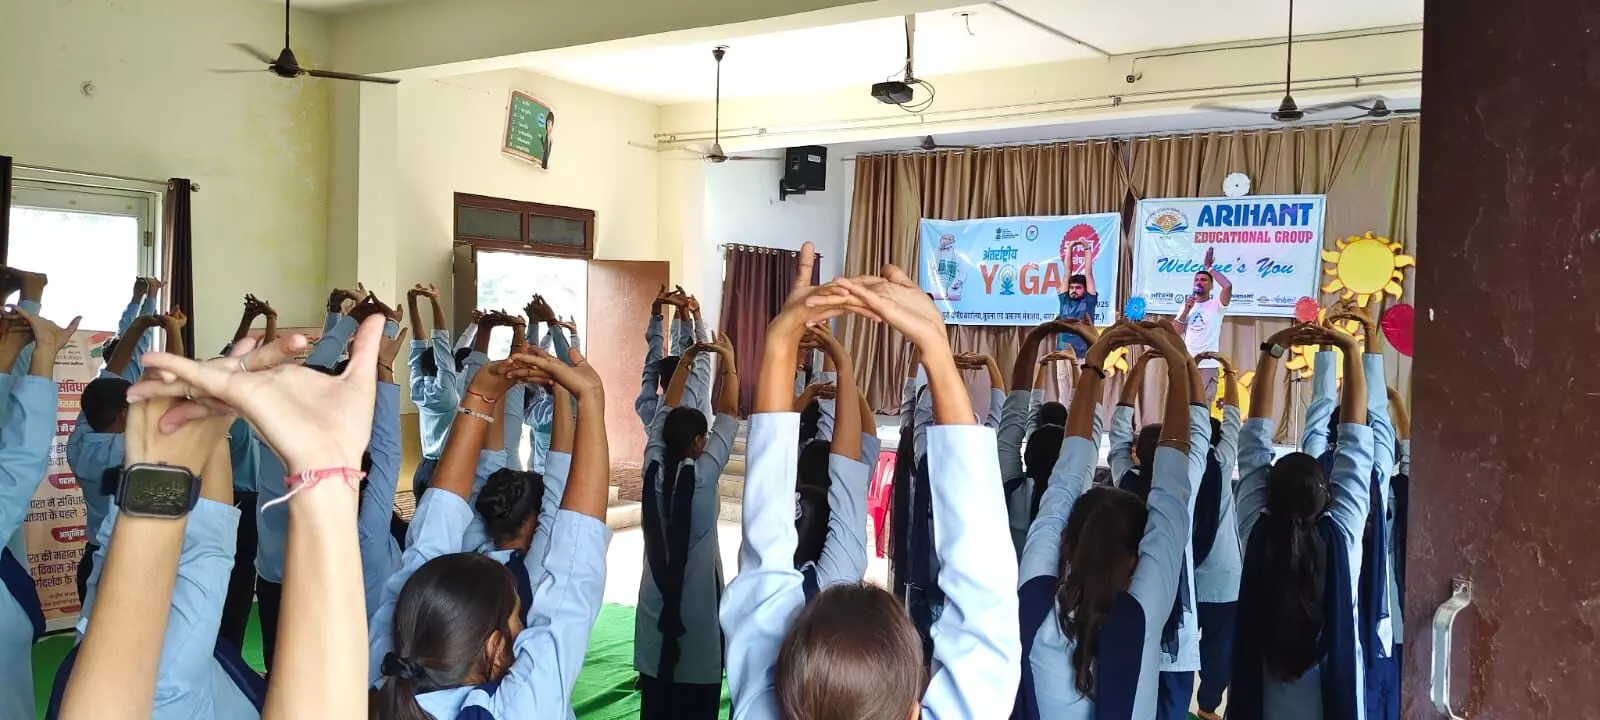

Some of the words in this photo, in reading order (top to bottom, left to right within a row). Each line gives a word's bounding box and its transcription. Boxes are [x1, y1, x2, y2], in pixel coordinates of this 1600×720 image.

[1197, 203, 1314, 228] ARIHANT
[1194, 231, 1271, 244] EDUCATIONAL
[1274, 230, 1314, 243] GROUP
[1256, 257, 1295, 279] You
[57, 378, 88, 393] संविधा
